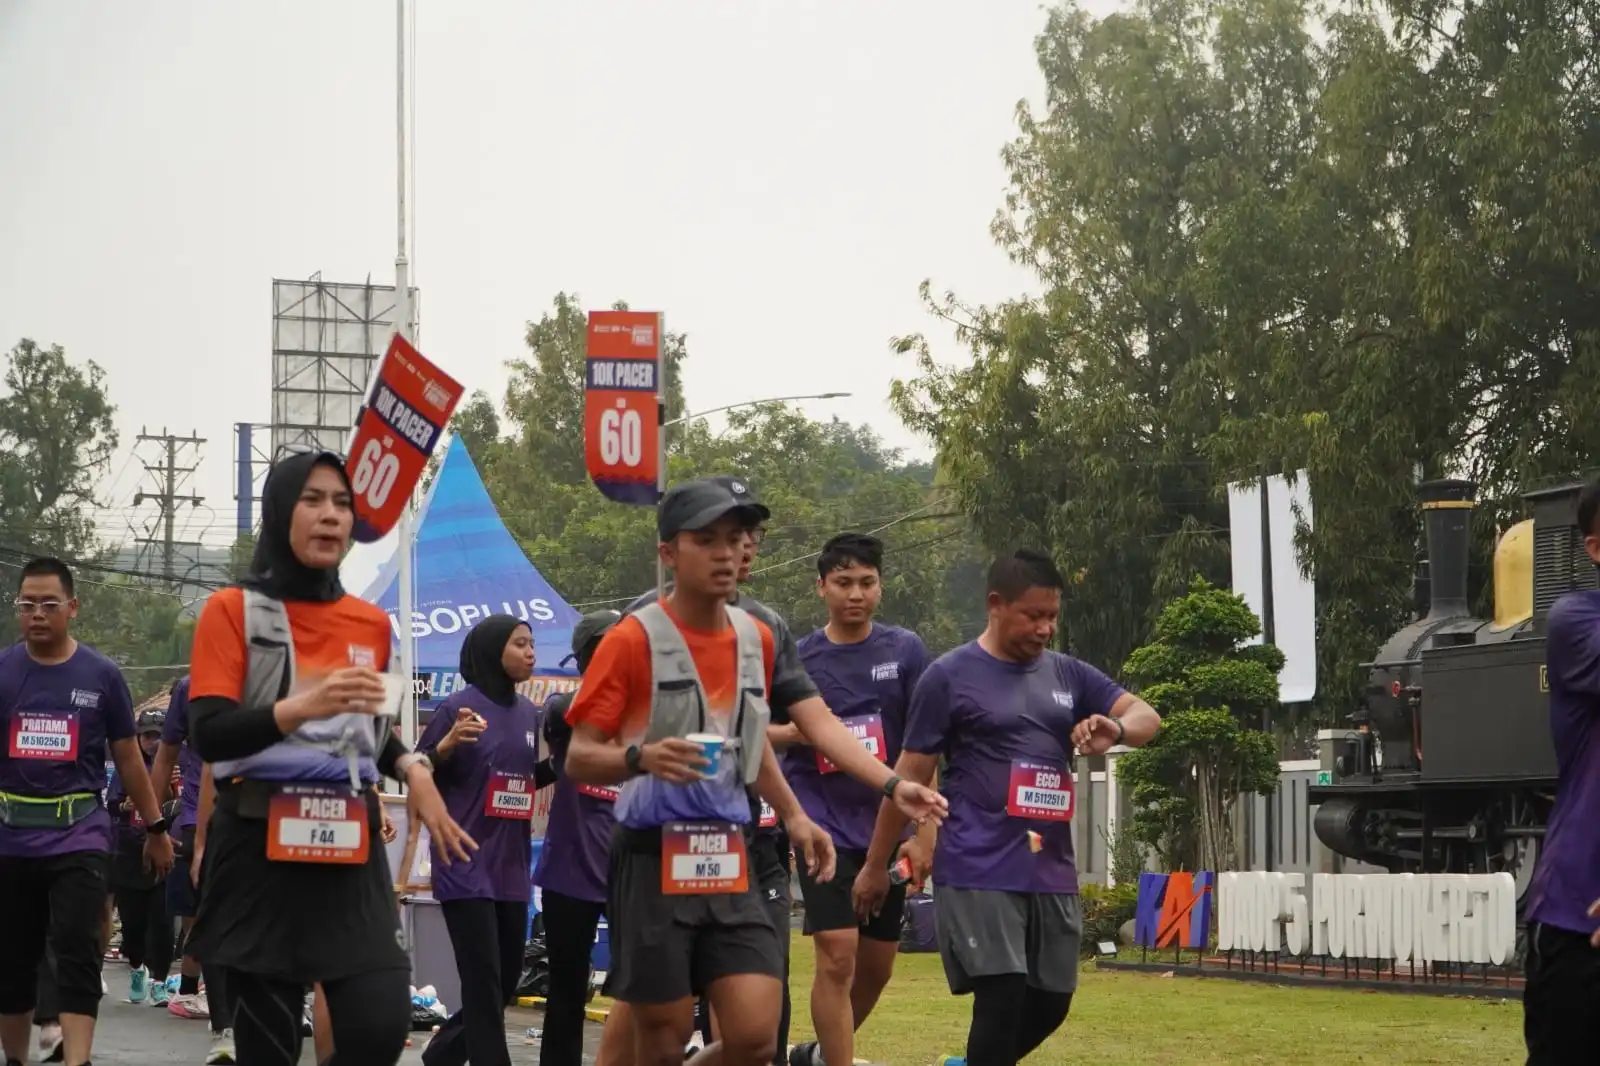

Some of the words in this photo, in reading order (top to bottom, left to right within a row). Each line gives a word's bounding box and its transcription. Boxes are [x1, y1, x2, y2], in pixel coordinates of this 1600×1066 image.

[592, 362, 614, 386] 10K
[616, 362, 654, 388] PACER
[375, 386, 397, 420] 10K
[390, 402, 434, 450] PACER
[600, 409, 642, 467] 60
[352, 438, 400, 510] 60
[22, 718, 68, 733] PRATAMA
[21, 735, 29, 745] M
[1035, 772, 1061, 789] ECCO
[1024, 790, 1033, 802] M
[300, 797, 347, 820] PACER
[310, 829, 317, 844] F
[319, 830, 335, 844] 44
[689, 834, 728, 853] PACER
[696, 863, 706, 877] M
[708, 863, 720, 877] 50
[1134, 871, 1213, 949] KAI
[1218, 871, 1283, 952] DAOP
[1285, 872, 1310, 956] 5
